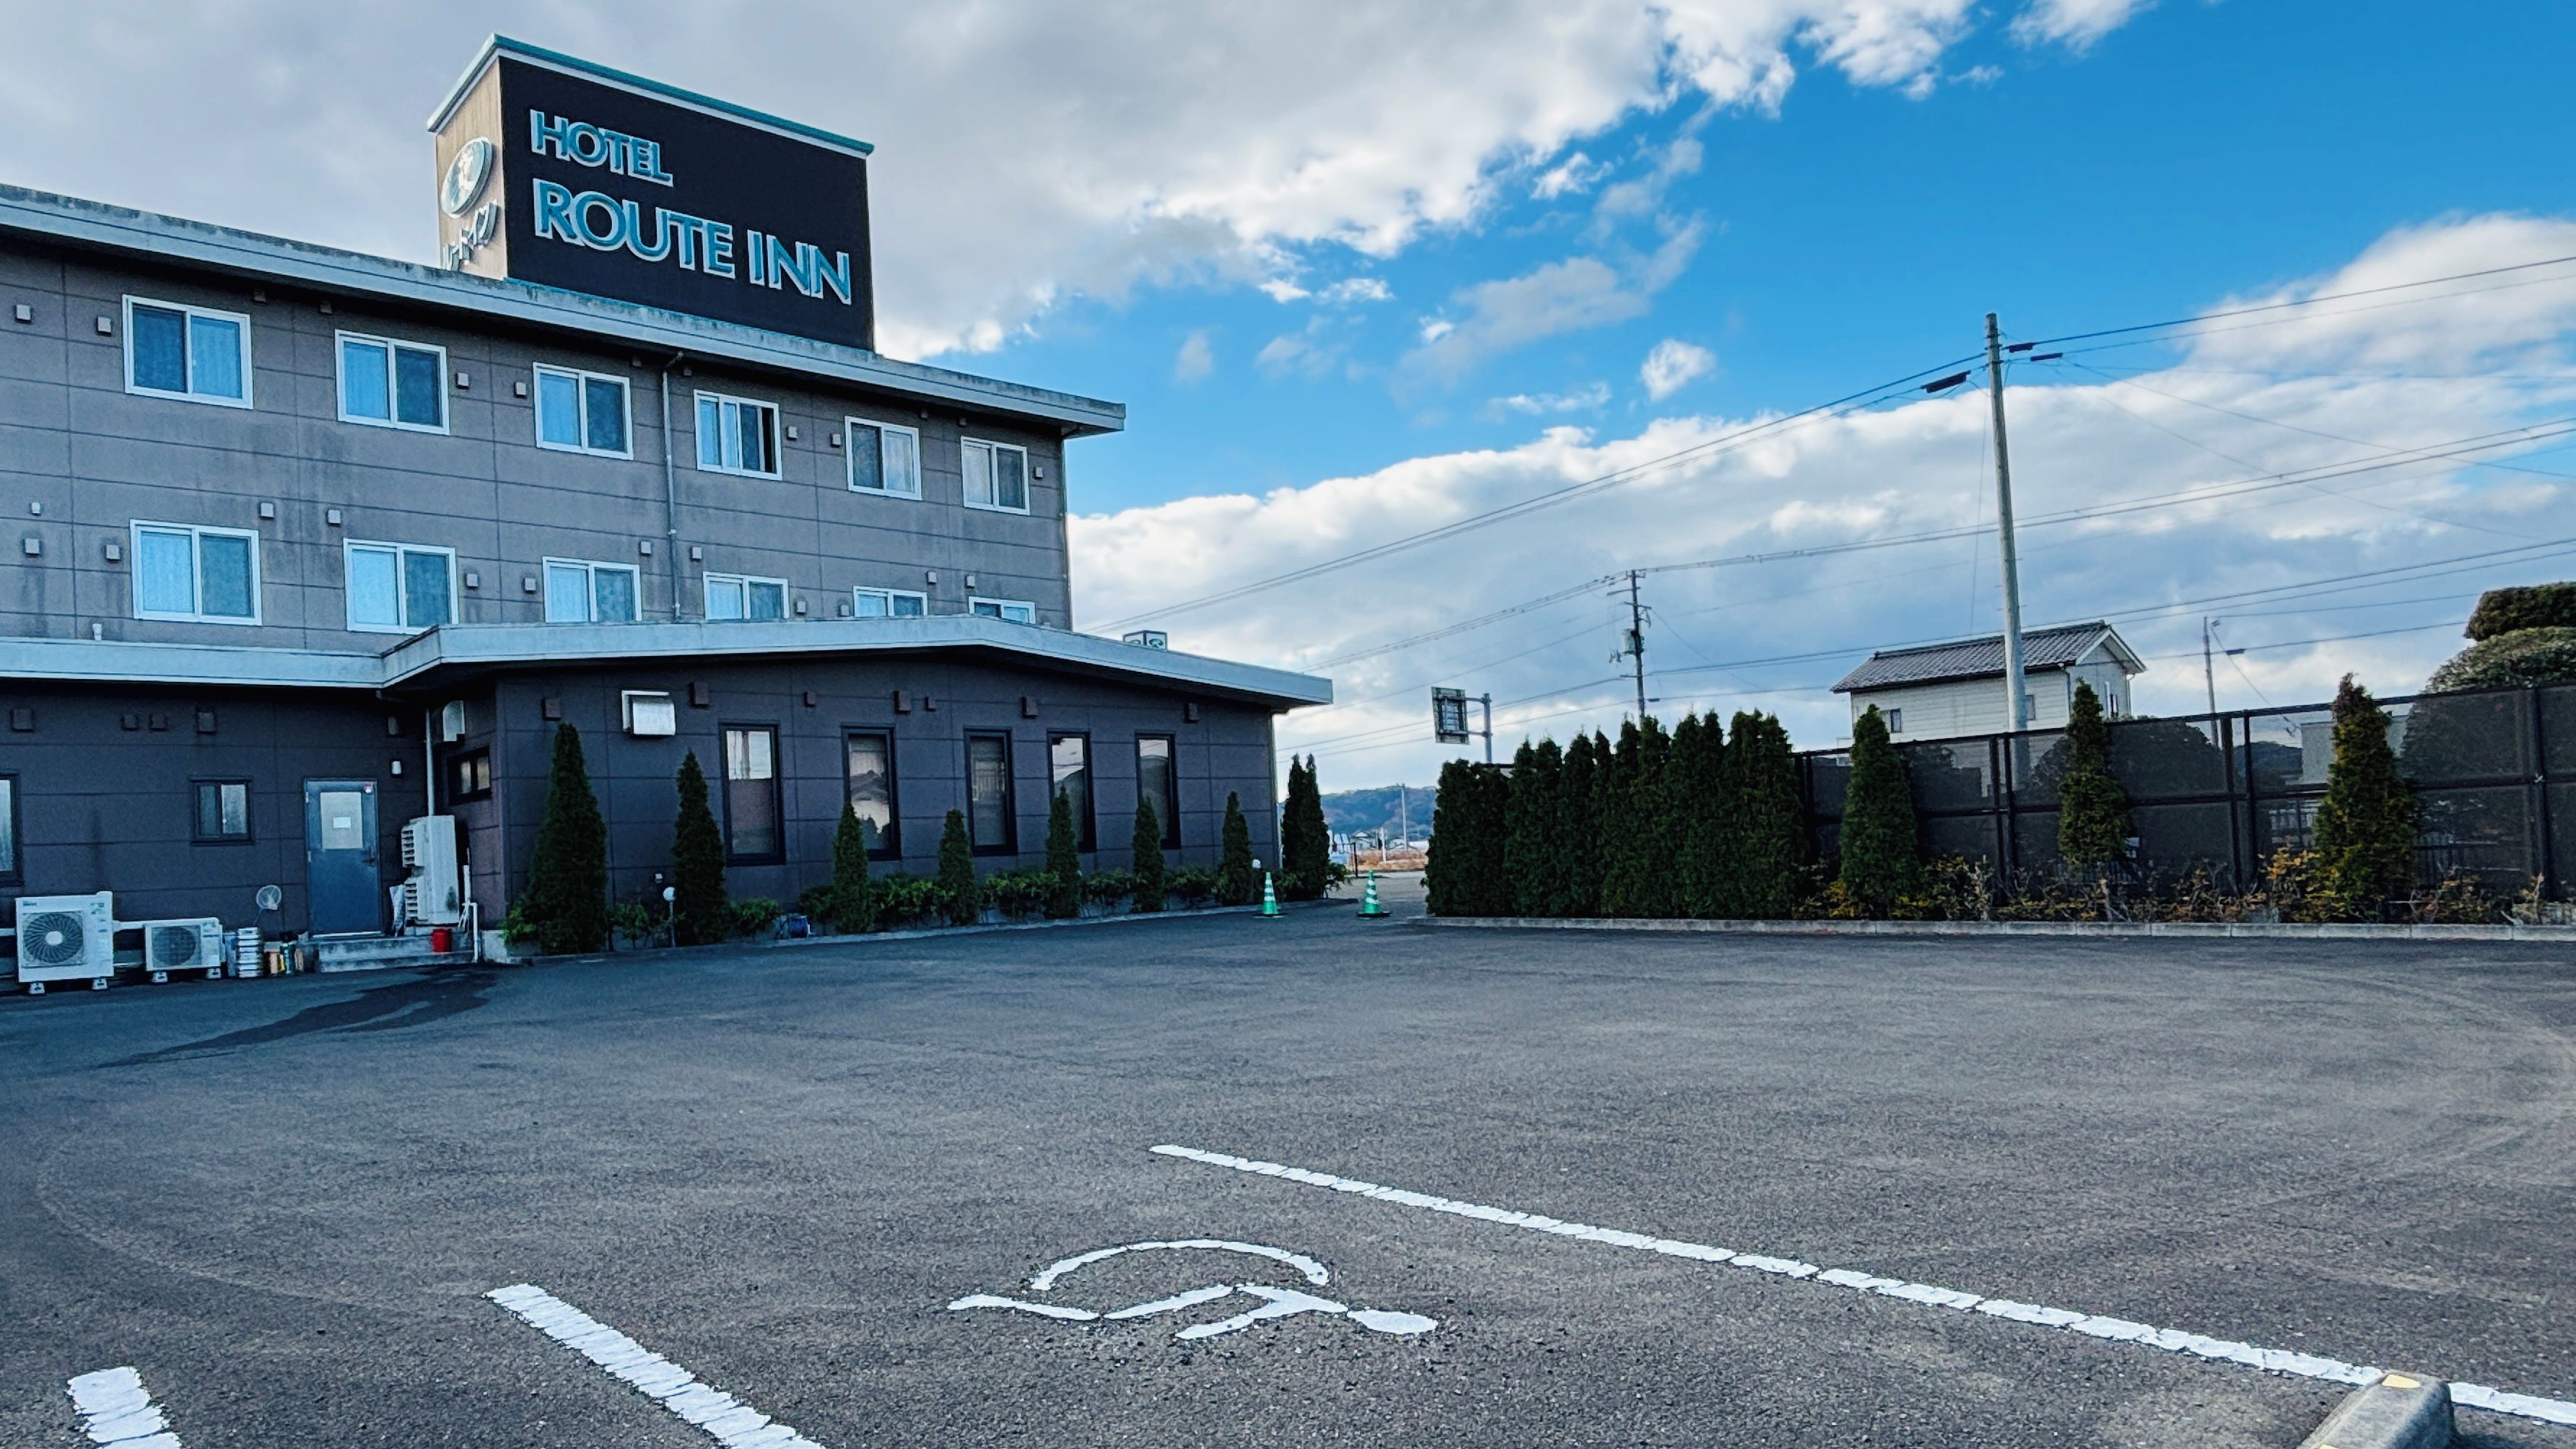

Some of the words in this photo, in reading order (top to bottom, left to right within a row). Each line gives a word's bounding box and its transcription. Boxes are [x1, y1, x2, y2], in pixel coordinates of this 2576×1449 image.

[530, 109, 673, 187] HOTEL
[533, 178, 735, 279] ROUTE
[747, 229, 852, 305] INN
